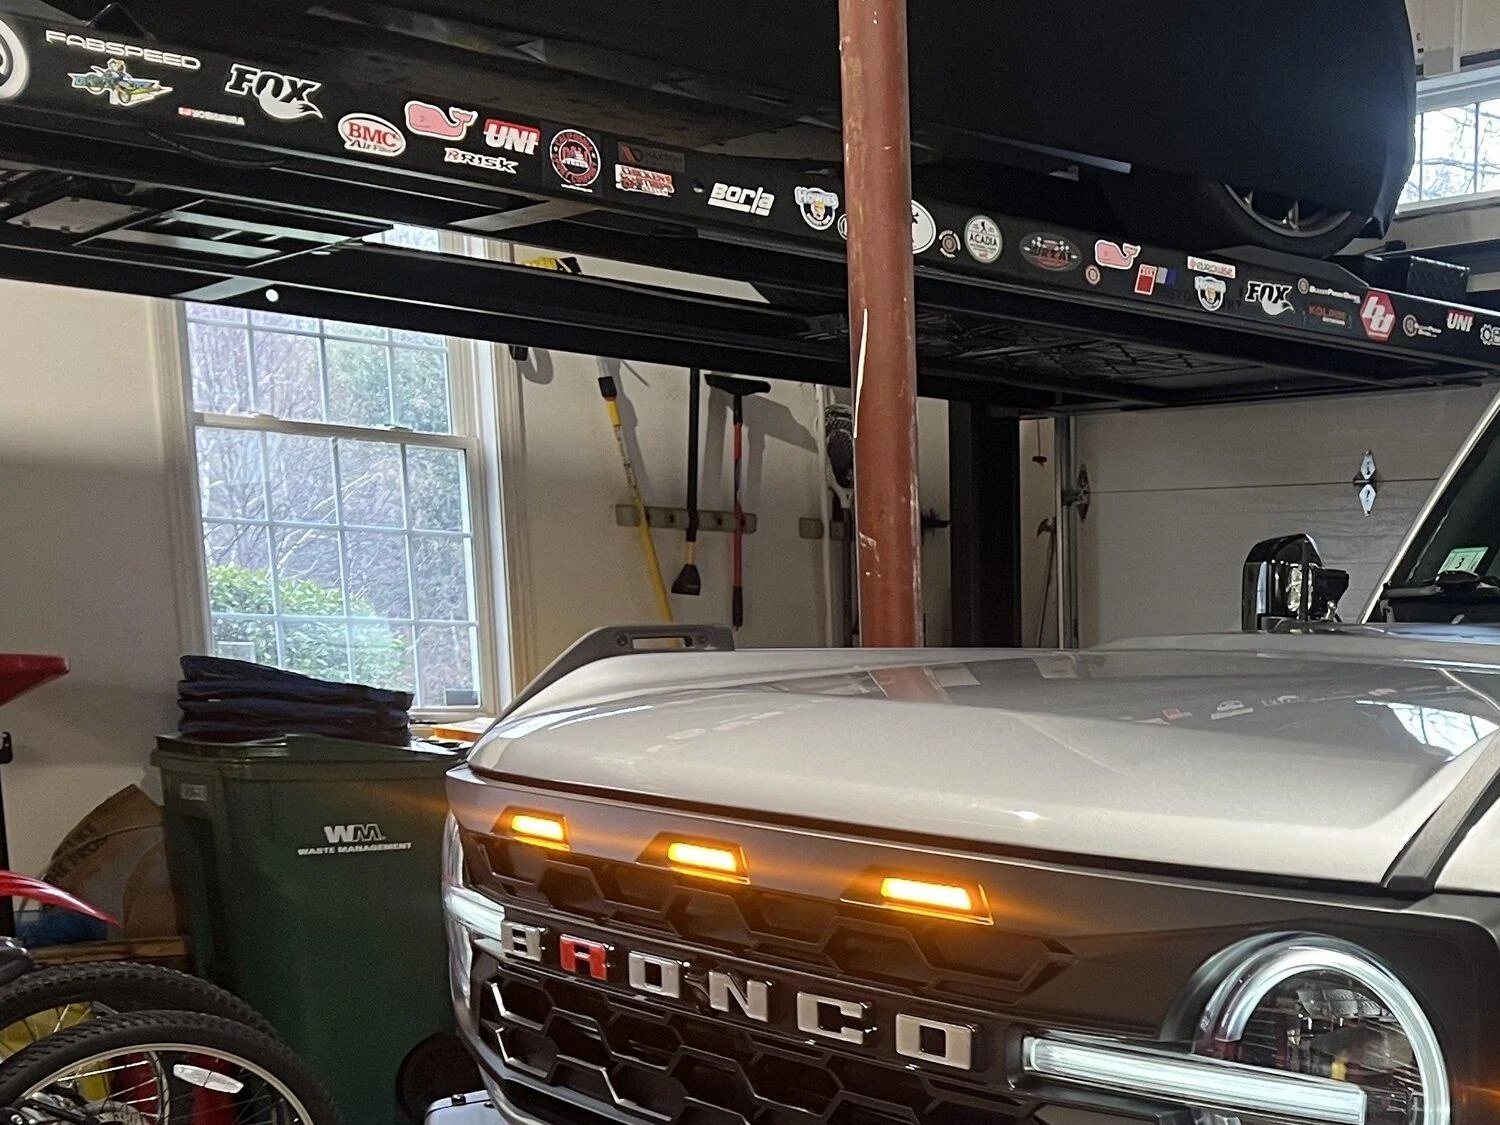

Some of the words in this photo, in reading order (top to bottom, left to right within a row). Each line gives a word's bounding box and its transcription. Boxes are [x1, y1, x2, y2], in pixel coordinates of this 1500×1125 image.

[45, 29, 201, 70] FABSPEED
[226, 64, 322, 108] FOX
[348, 122, 397, 149] BMC
[484, 122, 539, 156] UNI
[461, 151, 517, 173] RISK
[969, 232, 998, 247] ACADIA
[1246, 281, 1291, 304] FOX
[1446, 312, 1474, 333] UNI
[323, 823, 386, 844] WM
[297, 846, 336, 856] WASTE
[337, 842, 412, 853] MANAGEMENT
[500, 918, 976, 1071] BRONCO
